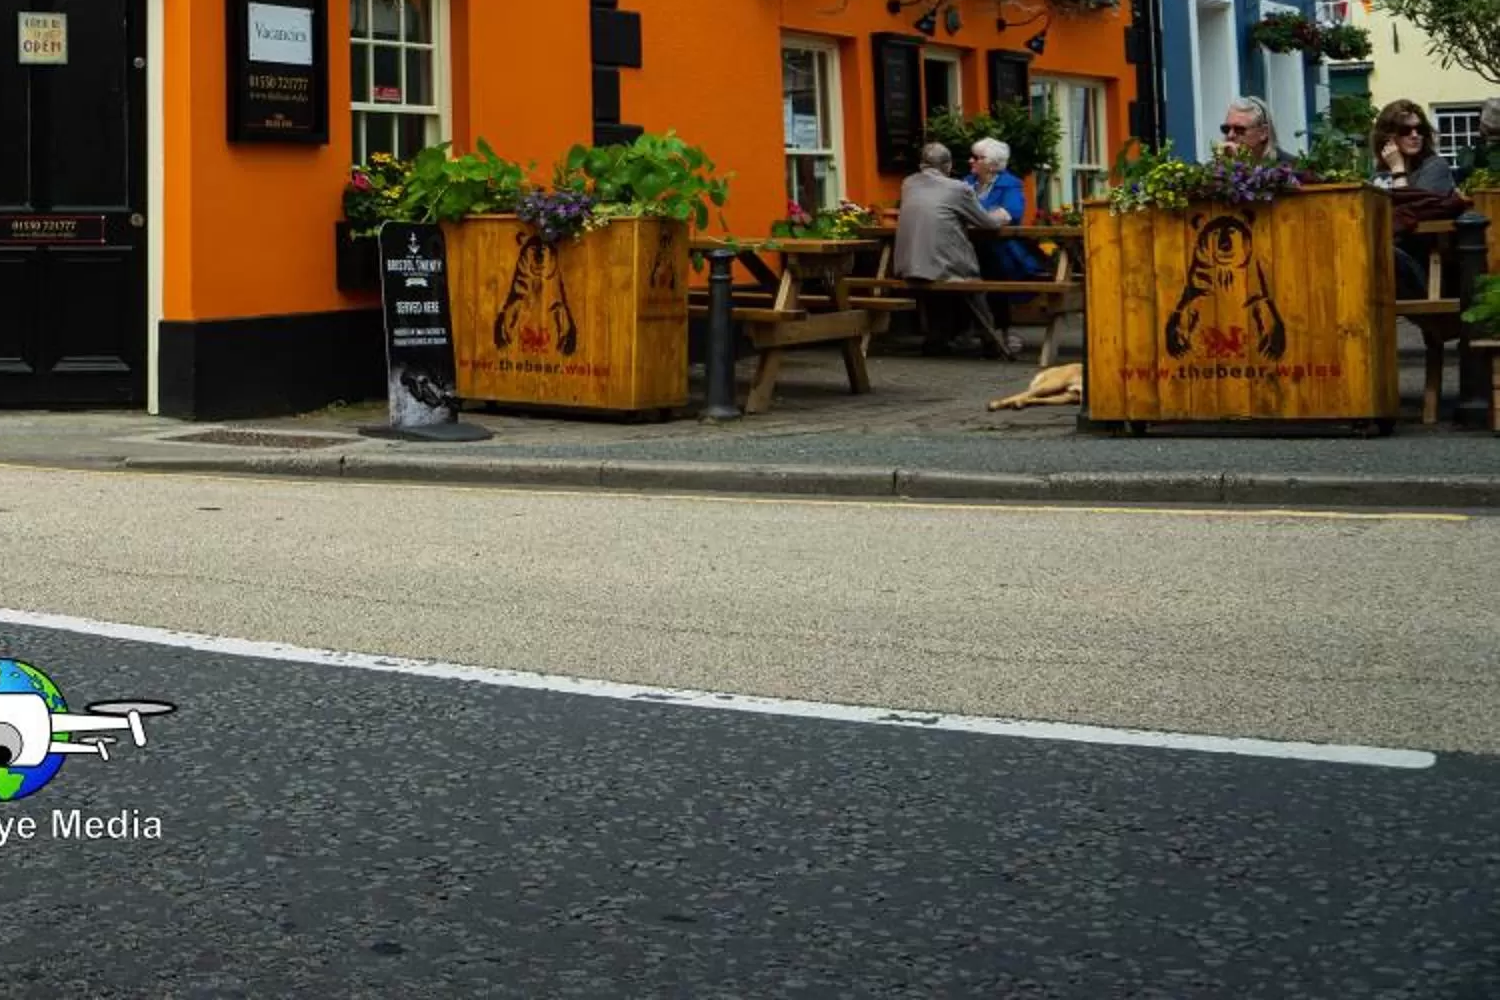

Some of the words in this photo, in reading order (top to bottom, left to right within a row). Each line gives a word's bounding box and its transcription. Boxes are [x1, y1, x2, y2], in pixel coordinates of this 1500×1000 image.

[255, 20, 308, 42] Vacancies
[23, 40, 62, 53] OPEN
[396, 301, 422, 314] SERVED
[424, 301, 440, 313] HERE
